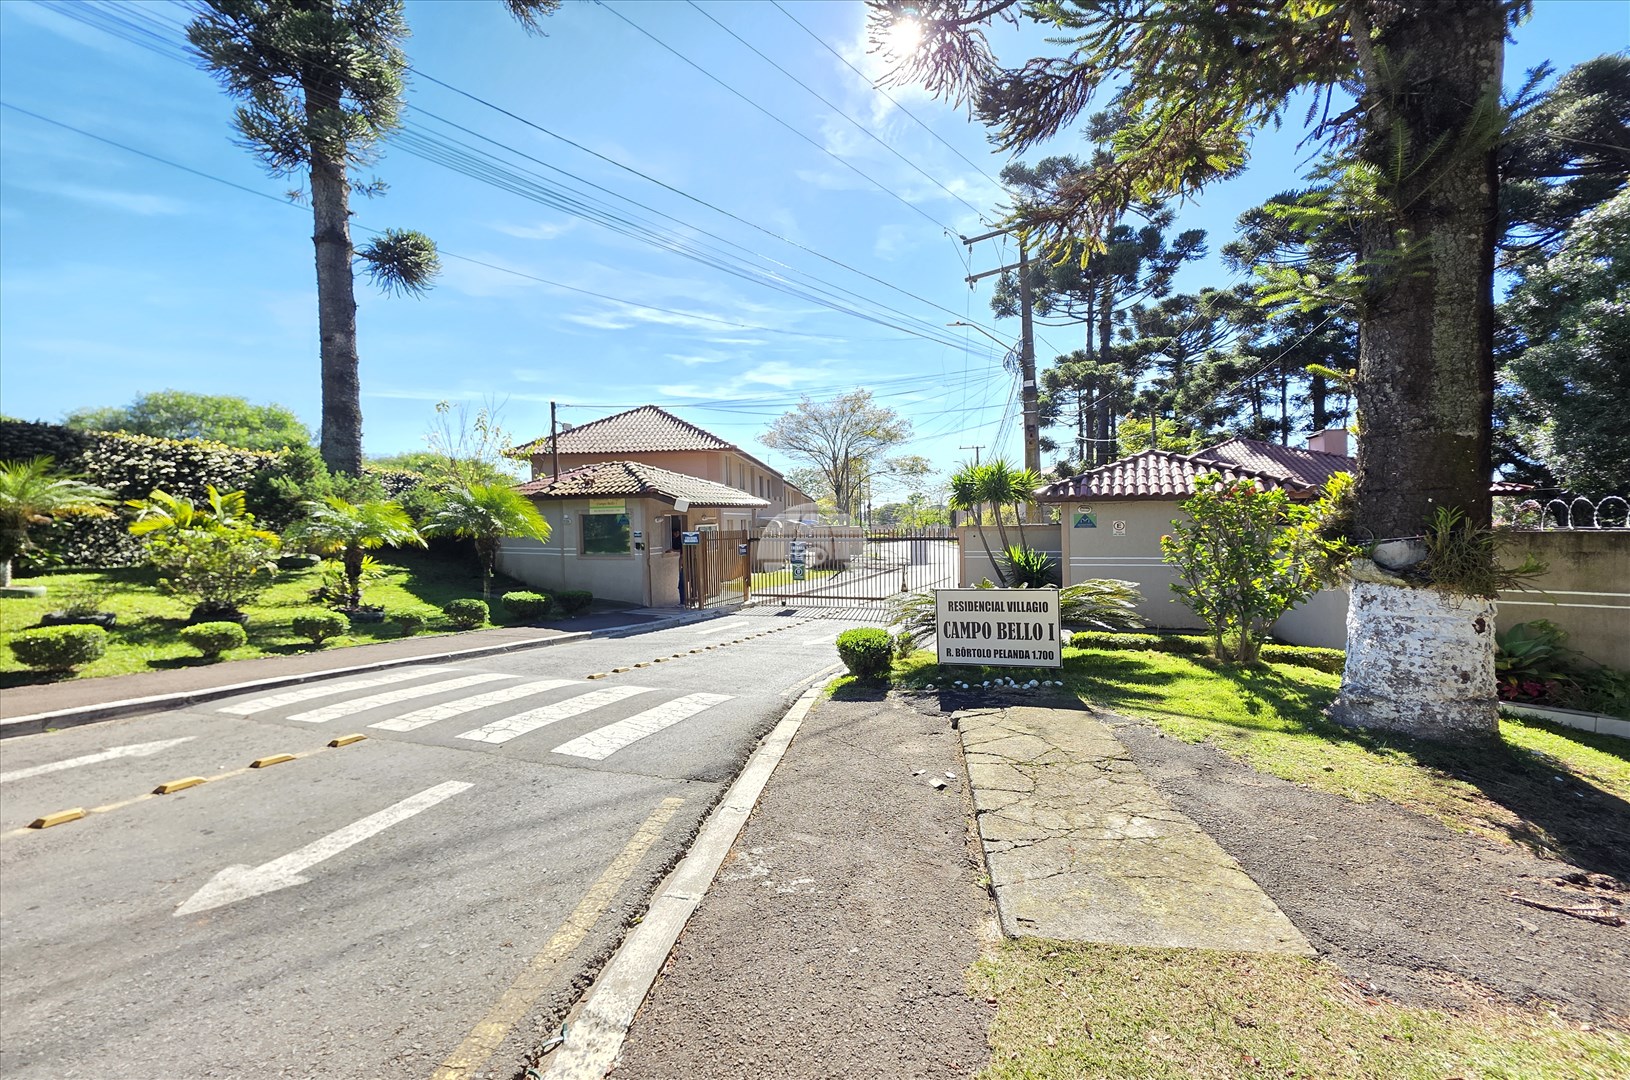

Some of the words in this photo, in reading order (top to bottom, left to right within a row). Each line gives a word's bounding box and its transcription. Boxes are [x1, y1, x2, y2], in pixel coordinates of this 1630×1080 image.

[948, 601, 1005, 612] RESIDENCIAL
[1007, 601, 1048, 612] VILLAGIO
[943, 621, 992, 640] CAMPO
[996, 622, 1043, 641] BELLO
[1048, 623, 1055, 641] I
[946, 647, 954, 657] R.
[993, 649, 1030, 660] PELANDA
[1031, 650, 1054, 660] 1.700
